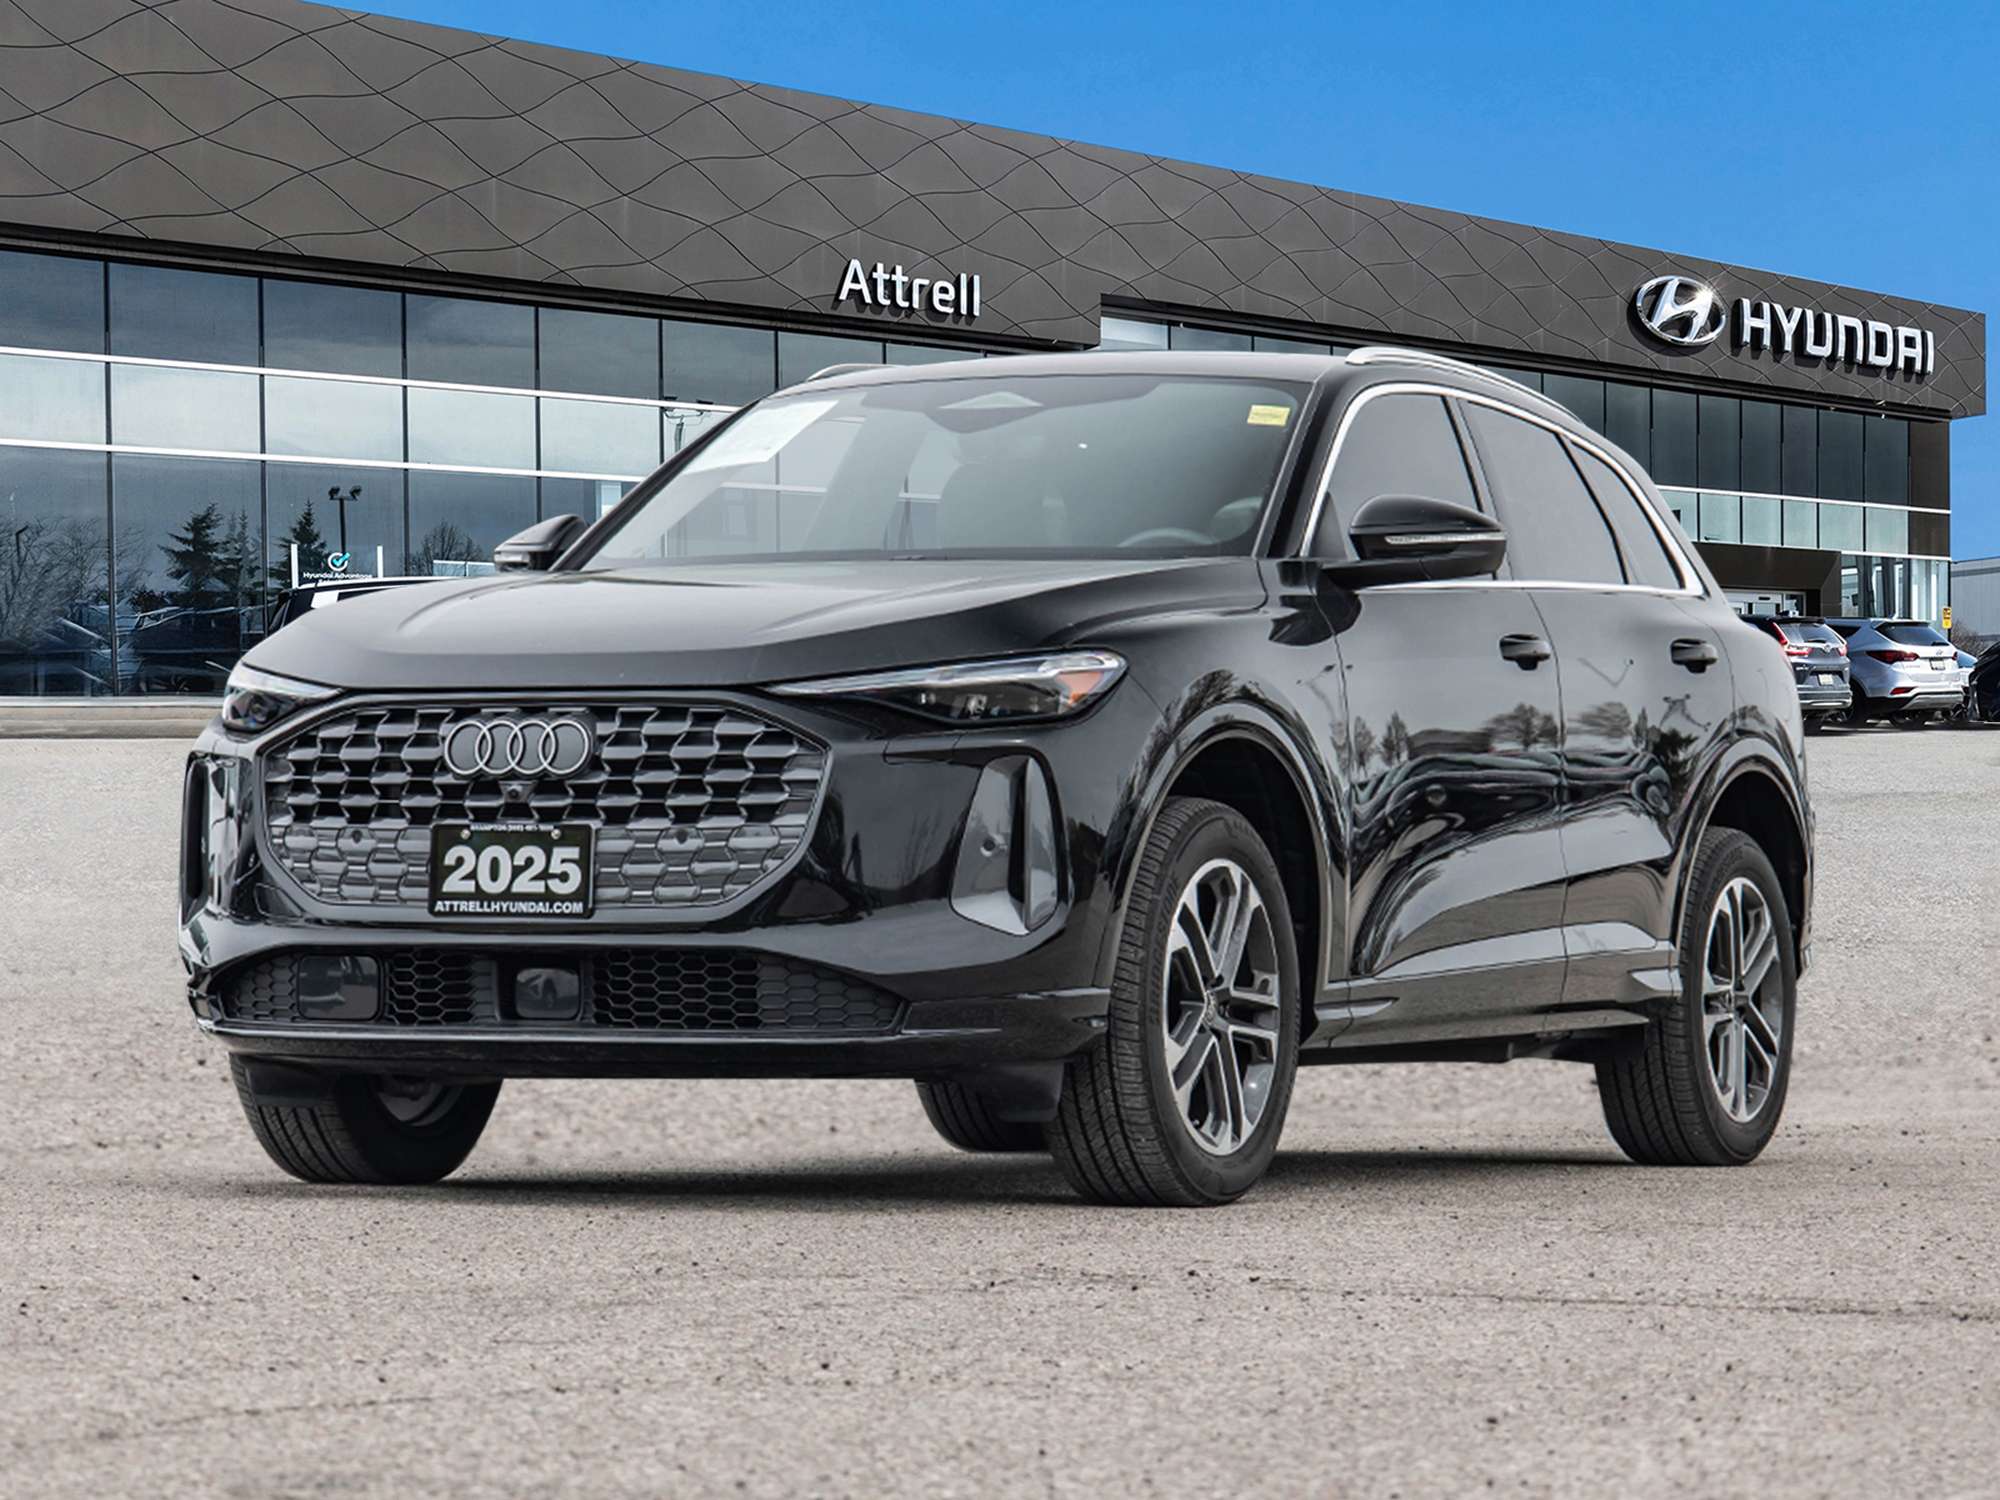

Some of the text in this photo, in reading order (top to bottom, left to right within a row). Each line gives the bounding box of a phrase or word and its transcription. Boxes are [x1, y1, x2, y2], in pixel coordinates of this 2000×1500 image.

[838, 258, 981, 317] Attrell
[1739, 298, 1936, 375] HYUNDAI
[303, 572, 333, 580] Hyundai
[441, 844, 582, 895] 2025
[434, 900, 584, 914] ATTRELLHYUNDAI.COM
